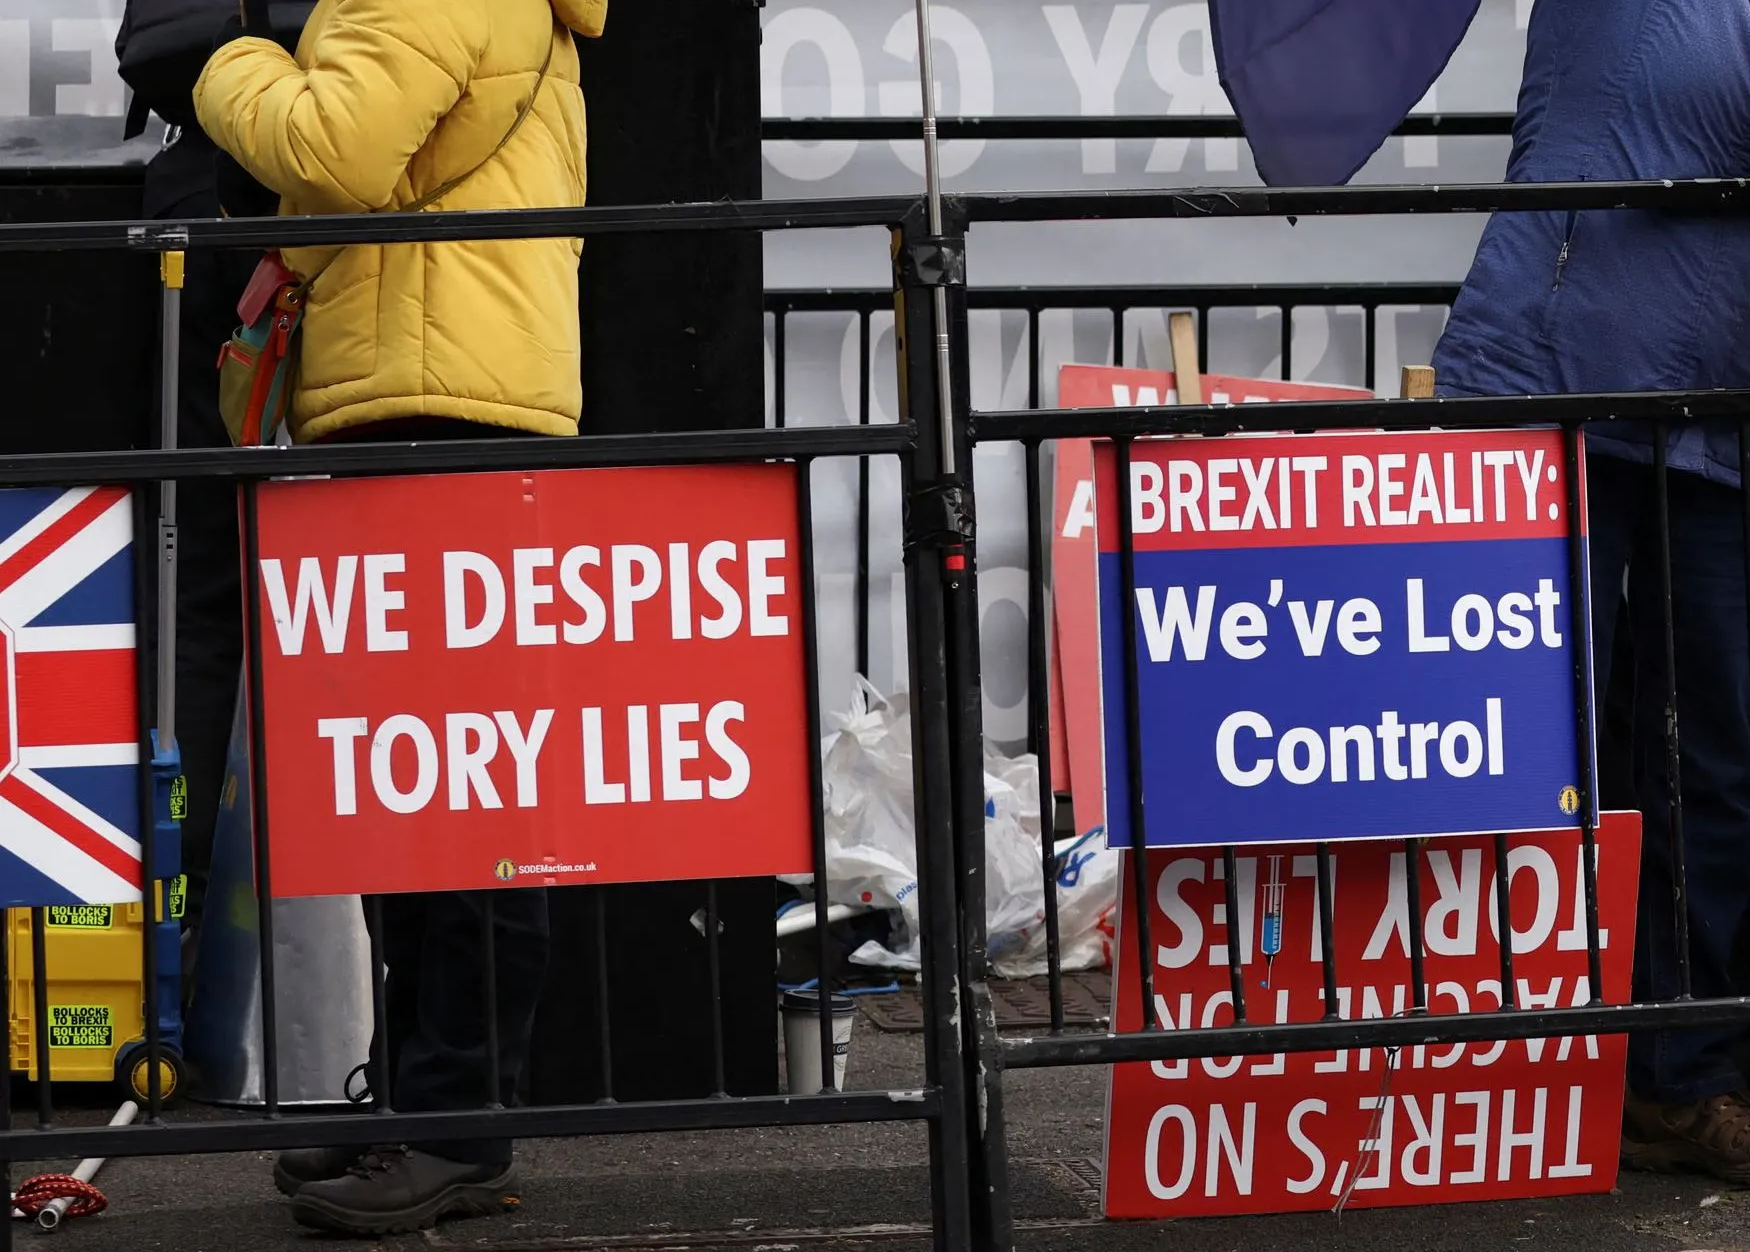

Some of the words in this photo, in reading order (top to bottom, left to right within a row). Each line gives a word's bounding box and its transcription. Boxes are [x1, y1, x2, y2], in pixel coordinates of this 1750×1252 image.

[1129, 456, 1328, 534] BREXIT
[1342, 449, 1560, 527] REALITY:
[260, 552, 409, 656] WE
[442, 538, 790, 650] DESPISE
[1135, 579, 1383, 663] We've
[1406, 578, 1563, 653] Lost
[318, 708, 556, 817] TORY
[581, 700, 752, 806] LIES
[1215, 697, 1504, 787] Control
[518, 861, 597, 875] SODEMaction.co.uk
[1361, 844, 1608, 961] TORY
[52, 906, 108, 917] BOLLOCKS
[54, 914, 68, 924] TO
[71, 915, 105, 925] BORIS
[53, 1007, 109, 1017] BOLLOCKS
[53, 1027, 109, 1036] BOLLOCKS
[55, 1016, 68, 1025] TO
[71, 1016, 108, 1025] BREXIT
[56, 1035, 70, 1045] TO
[73, 1035, 107, 1045] BORIS
[1144, 1101, 1257, 1201] NO
[1286, 1085, 1593, 1196] THERE'S
